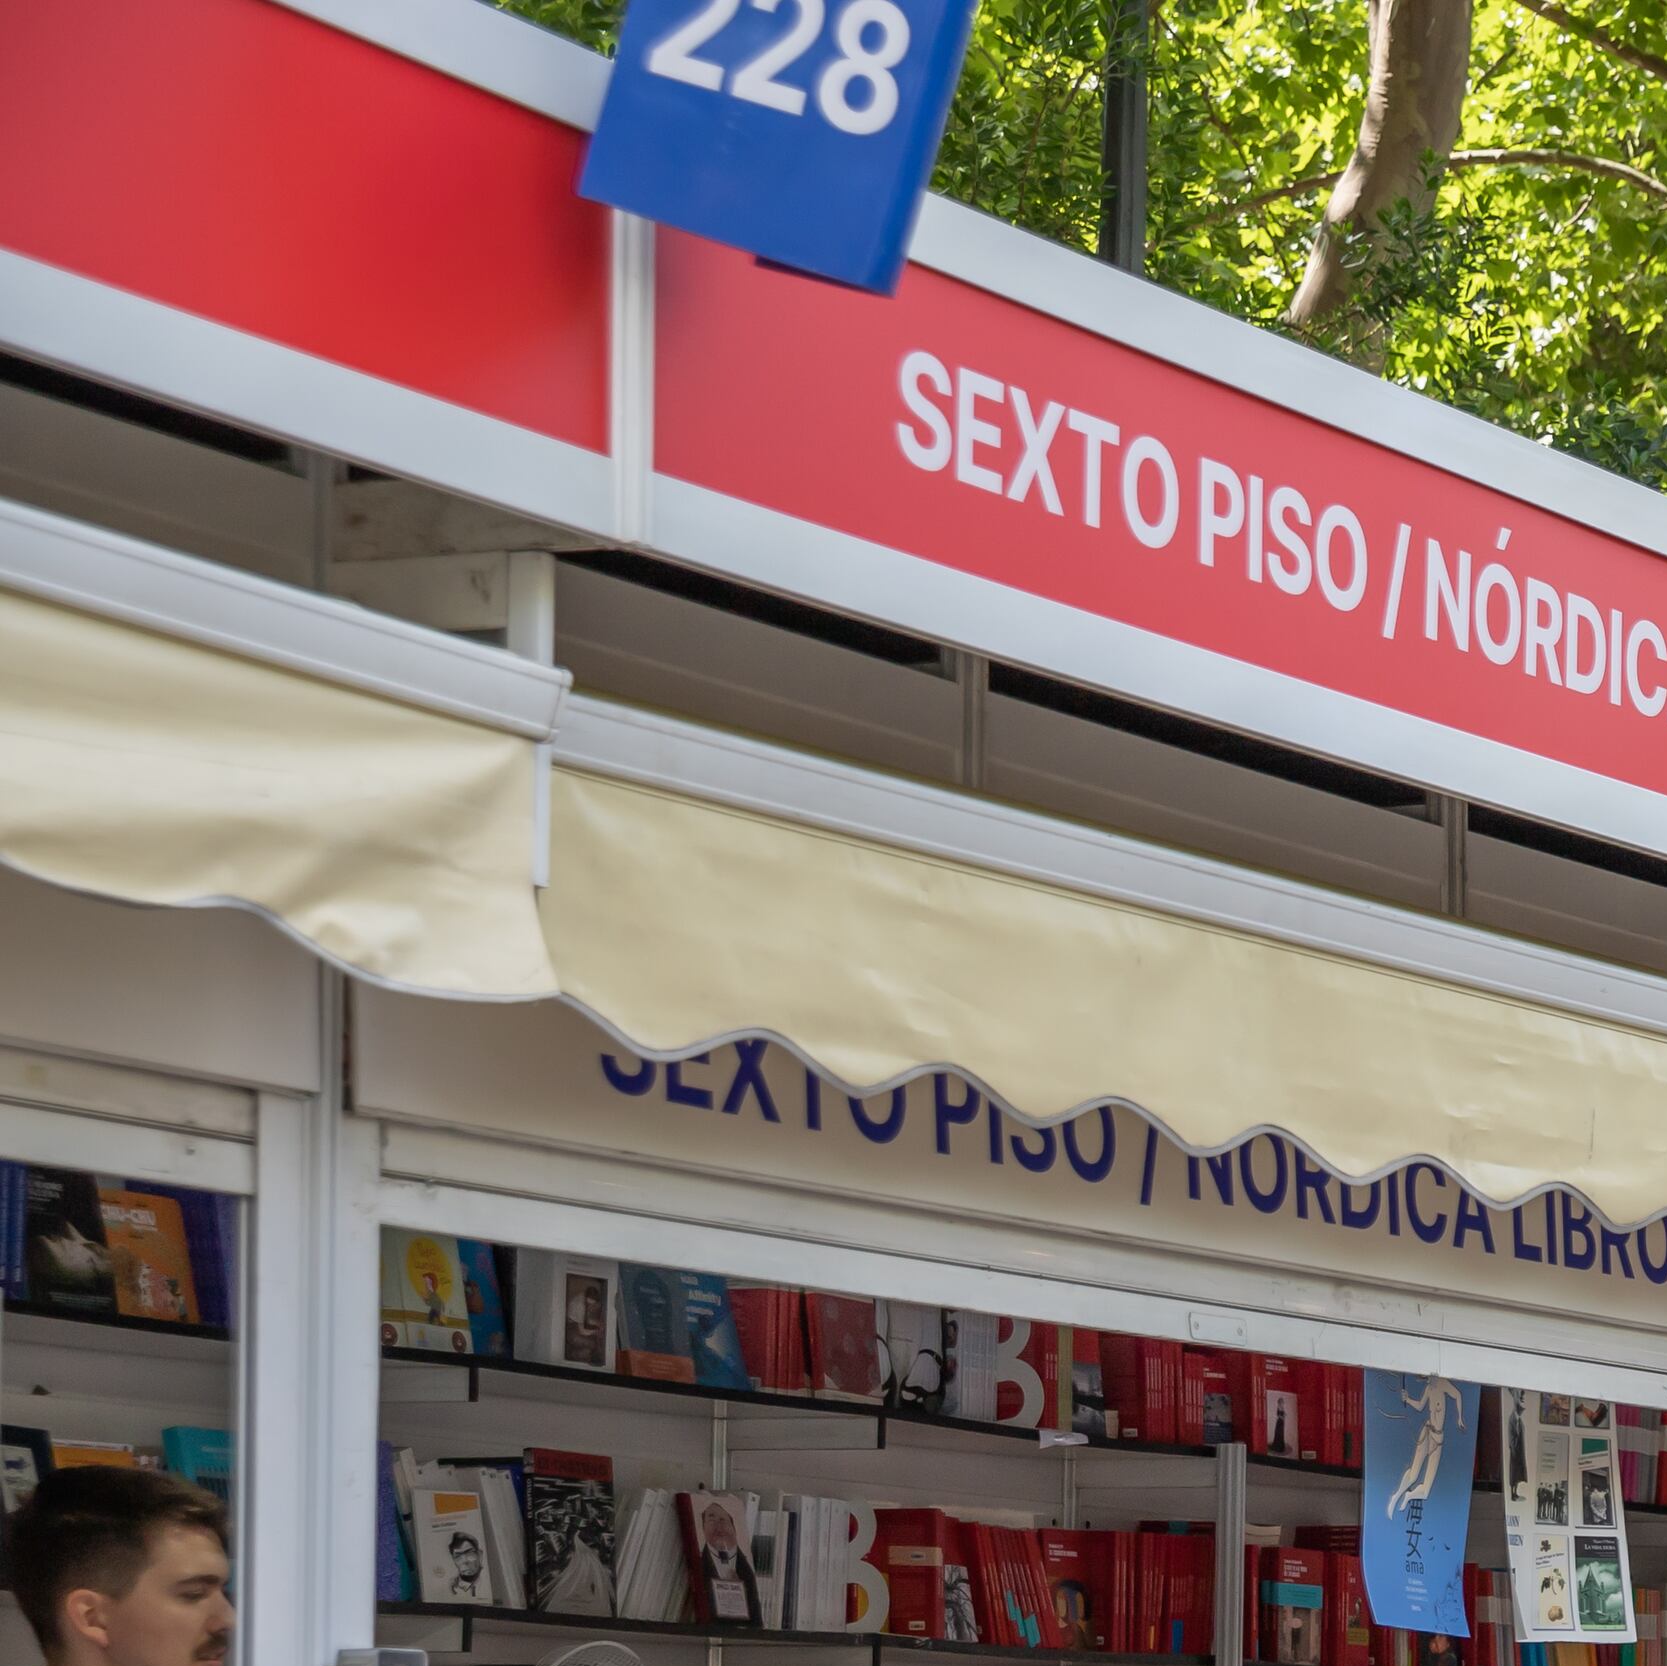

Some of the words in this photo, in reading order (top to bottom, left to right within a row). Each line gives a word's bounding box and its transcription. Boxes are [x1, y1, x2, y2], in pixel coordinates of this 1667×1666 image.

[647, 0, 911, 135] 228
[895, 350, 1179, 549] SEXTO
[1198, 456, 1368, 611] PISO
[1382, 523, 1411, 639] /
[1405, 1560, 1425, 1575] ama
